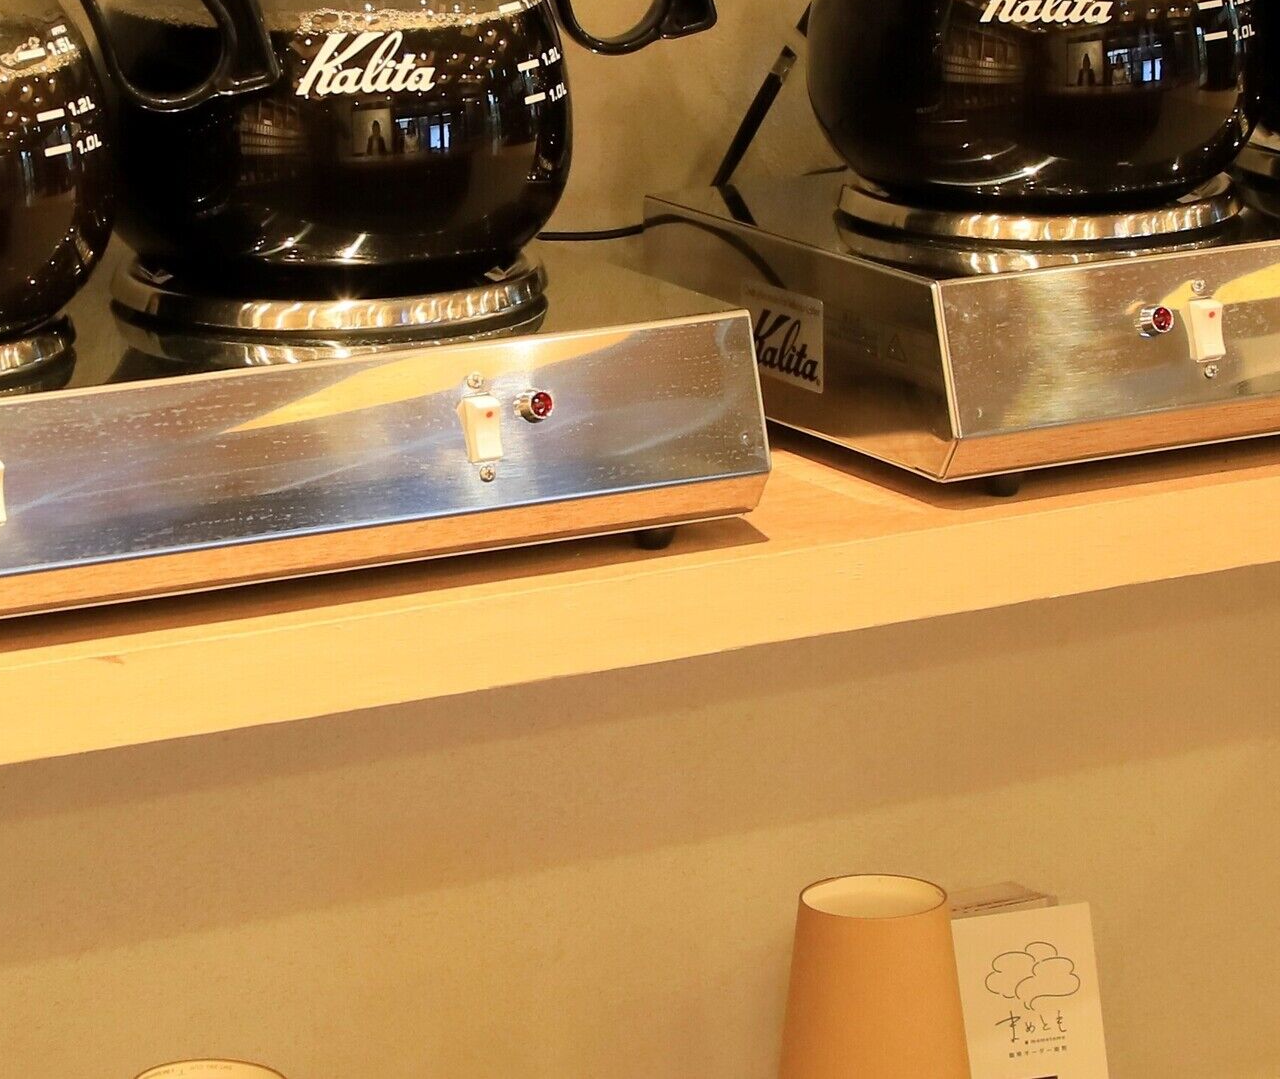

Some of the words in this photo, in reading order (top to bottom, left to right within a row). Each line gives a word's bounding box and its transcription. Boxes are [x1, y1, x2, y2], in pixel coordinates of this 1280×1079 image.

[1232, 23, 1256, 42] 1.0L
[46, 36, 76, 57] 1.5L
[541, 46, 561, 66] 1.2L
[295, 30, 436, 97] Kalita
[548, 82, 568, 102] 1.0L
[67, 95, 96, 117] 1.2L
[75, 133, 103, 155] 1.0L
[753, 309, 819, 381] Kalita
